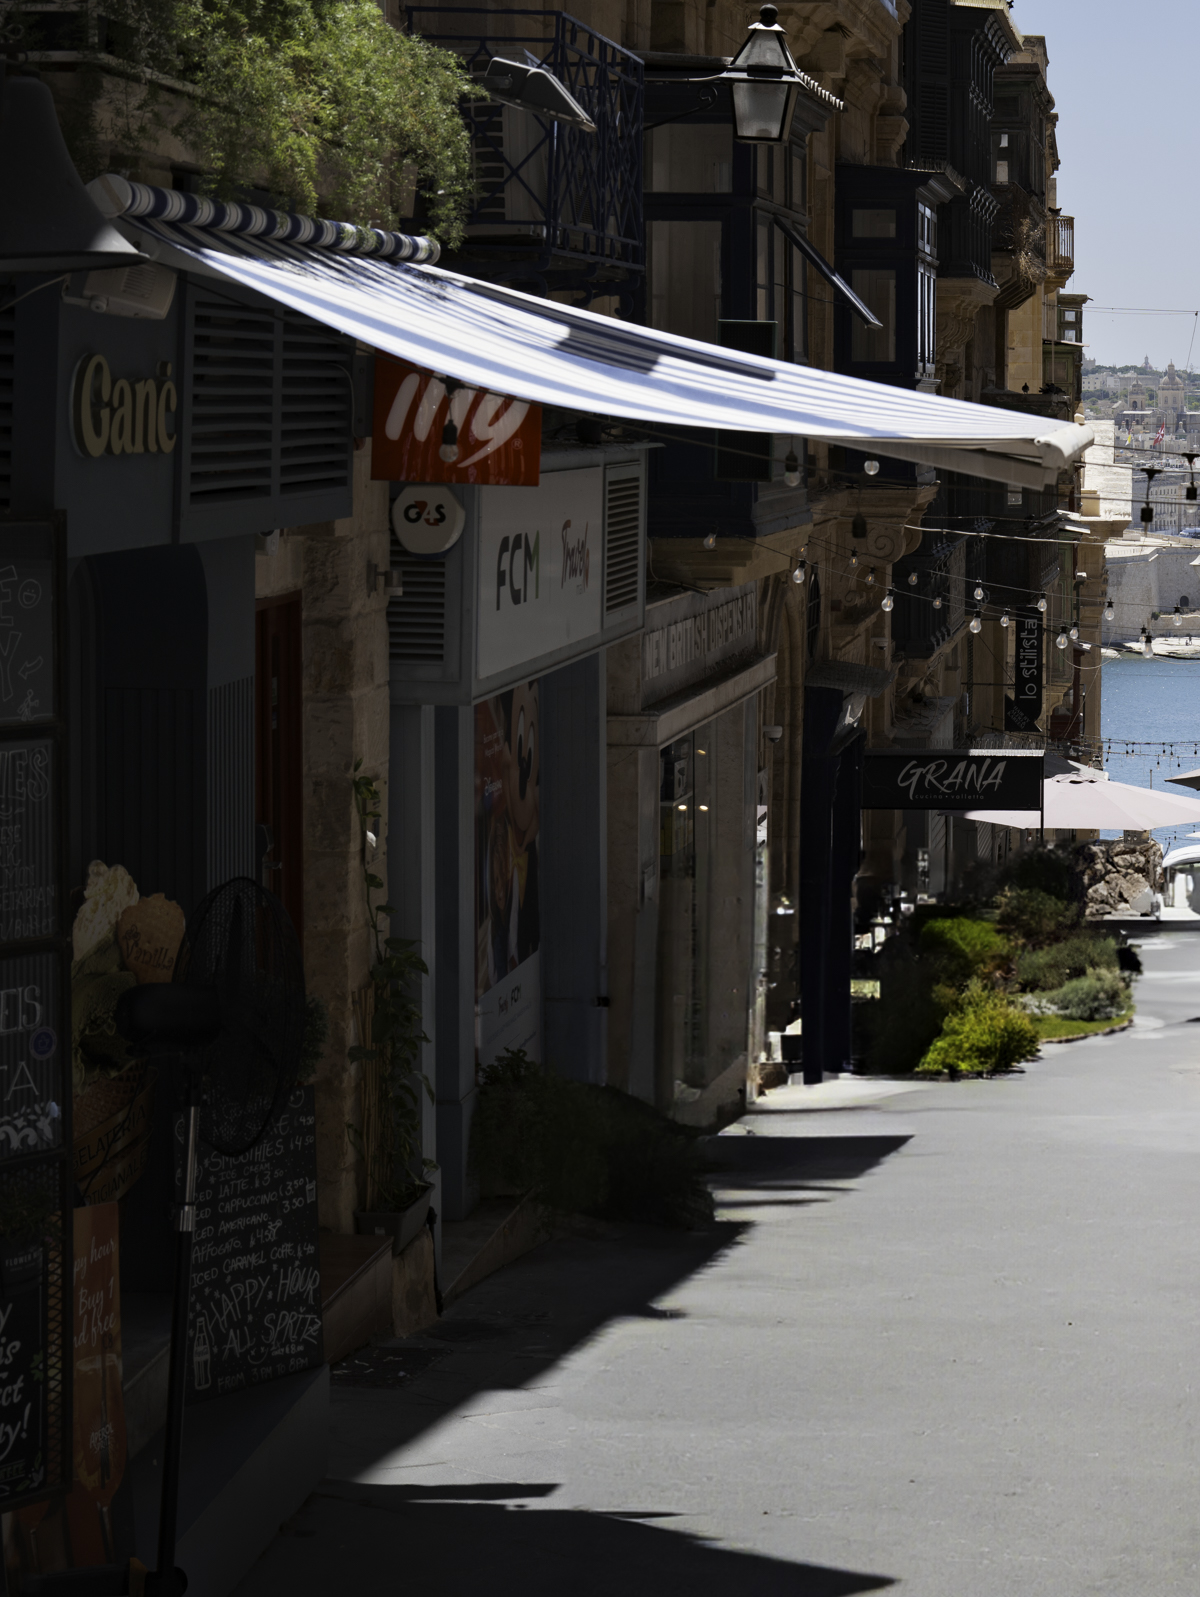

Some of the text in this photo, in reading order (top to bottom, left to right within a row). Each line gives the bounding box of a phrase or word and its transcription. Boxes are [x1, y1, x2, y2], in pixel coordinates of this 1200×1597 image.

[403, 500, 446, 527] G4S
[496, 529, 540, 612] FCM
[643, 592, 756, 681] NEW BRITISH DISPENSARY
[1019, 619, 1038, 678] stilista
[897, 758, 1008, 801] GRANA
[0, 884, 55, 911] ETARIAN
[90, 1236, 117, 1265] hour
[191, 1267, 219, 1289] ICED
[222, 1250, 267, 1275] CARAMEL
[78, 1276, 115, 1318] Buy 1
[202, 1266, 321, 1346] HAPPY HOUR
[91, 1305, 117, 1348] free
[221, 1326, 256, 1362] ALL
[217, 1371, 246, 1394] FROM
[277, 1363, 287, 1375] TO
